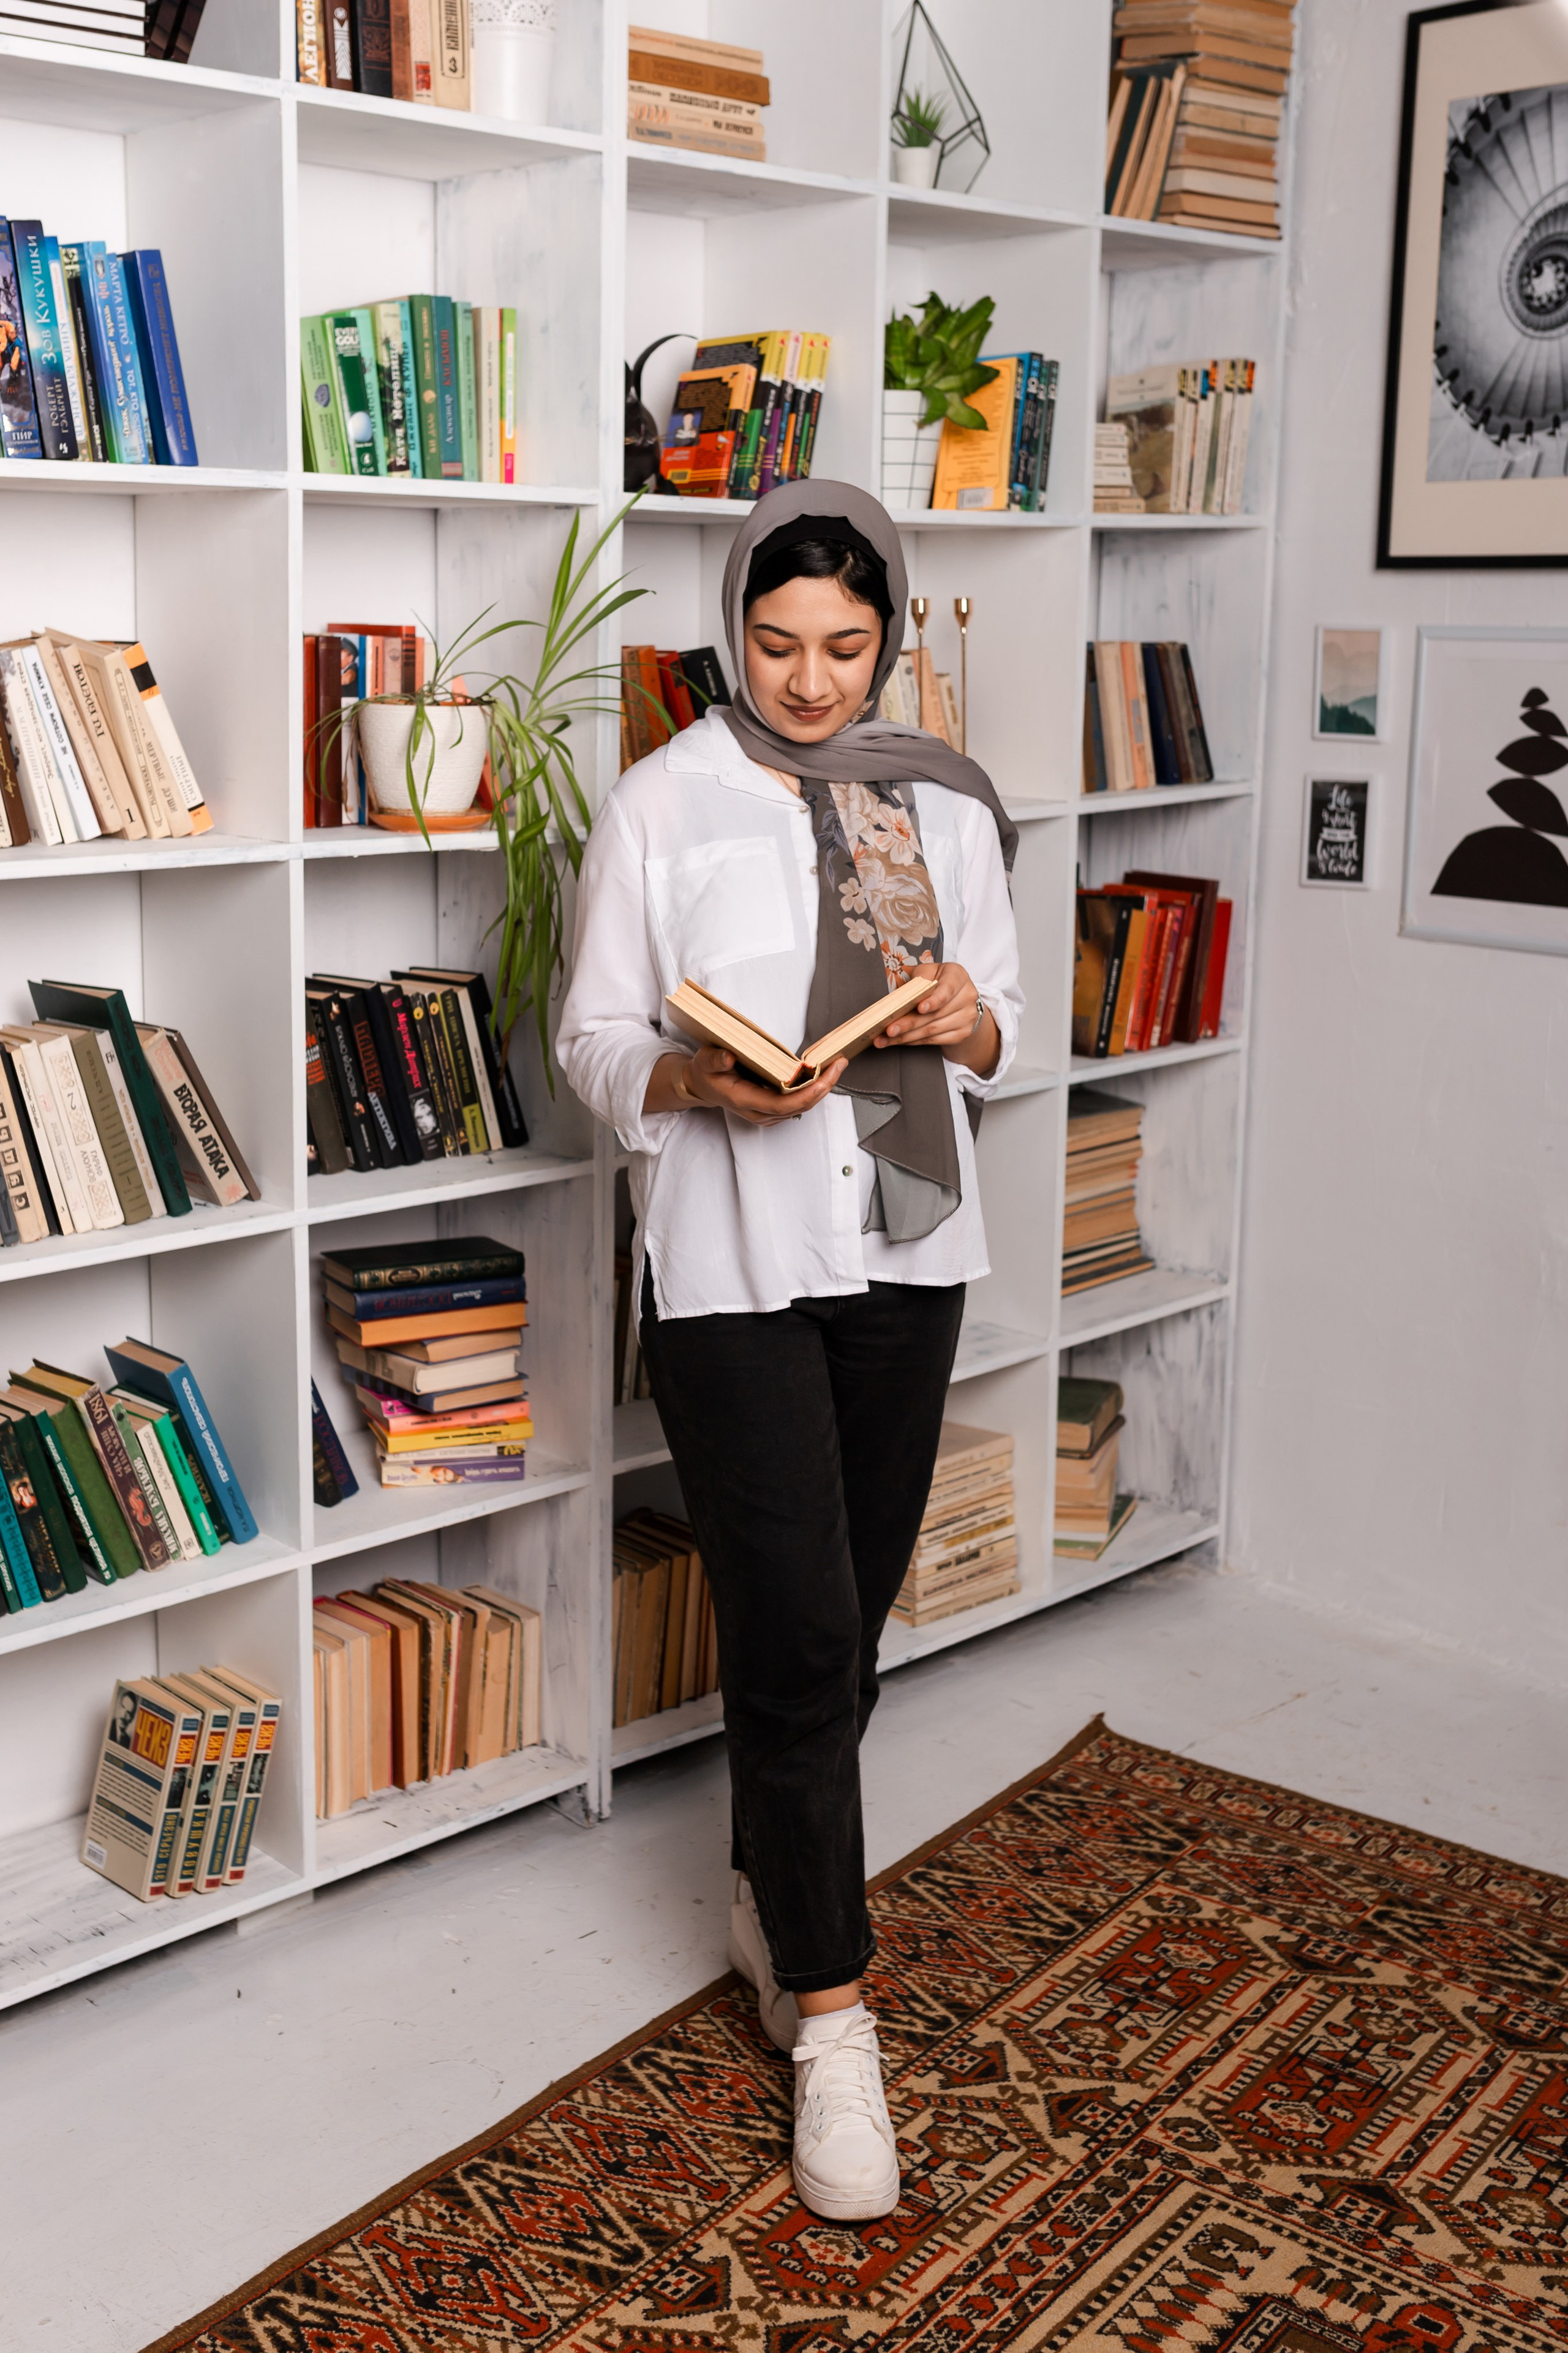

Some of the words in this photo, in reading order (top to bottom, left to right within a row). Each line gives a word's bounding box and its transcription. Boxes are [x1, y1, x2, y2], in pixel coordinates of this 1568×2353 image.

[108, 260, 124, 303] МАРТА
[115, 305, 130, 345] КЕТРО
[385, 339, 404, 420] Метелица
[47, 385, 59, 428] РОБЕРТ
[393, 427, 407, 466] Катя
[30, 661, 45, 689] КУМИРА
[70, 662, 99, 716] БРЕТОН
[42, 692, 53, 709] СЕБЕ
[48, 711, 64, 744] СОТВОРИ
[60, 746, 69, 755] НЕ
[145, 741, 166, 782] МЕРТВЫЕ
[161, 786, 178, 814] ДУШИ
[172, 1082, 209, 1135] ВТОРАЯ
[197, 1131, 232, 1180] АТАКА
[368, 1092, 397, 1150] ДЕТЕКТИВА
[78, 1149, 97, 1183] АХУНОВ
[89, 1150, 104, 1176] ГАРИФ
[181, 1377, 208, 1431] СЕВАСТОПОЛЬ
[201, 1430, 230, 1483] ГЕРОИЧЕСКИЙ
[44, 1434, 61, 1463] МИХАИЛ
[56, 1462, 75, 1495] ШОЛОХОВ
[69, 1495, 93, 1537] ПОДНЯТАЯ
[87, 1536, 108, 1571] ЦЕЛИНА
[131, 1456, 160, 1508] БУЛГАКОВ
[153, 1509, 179, 1555] МИХАИЛ
[154, 1862, 168, 1881] ЭТО
